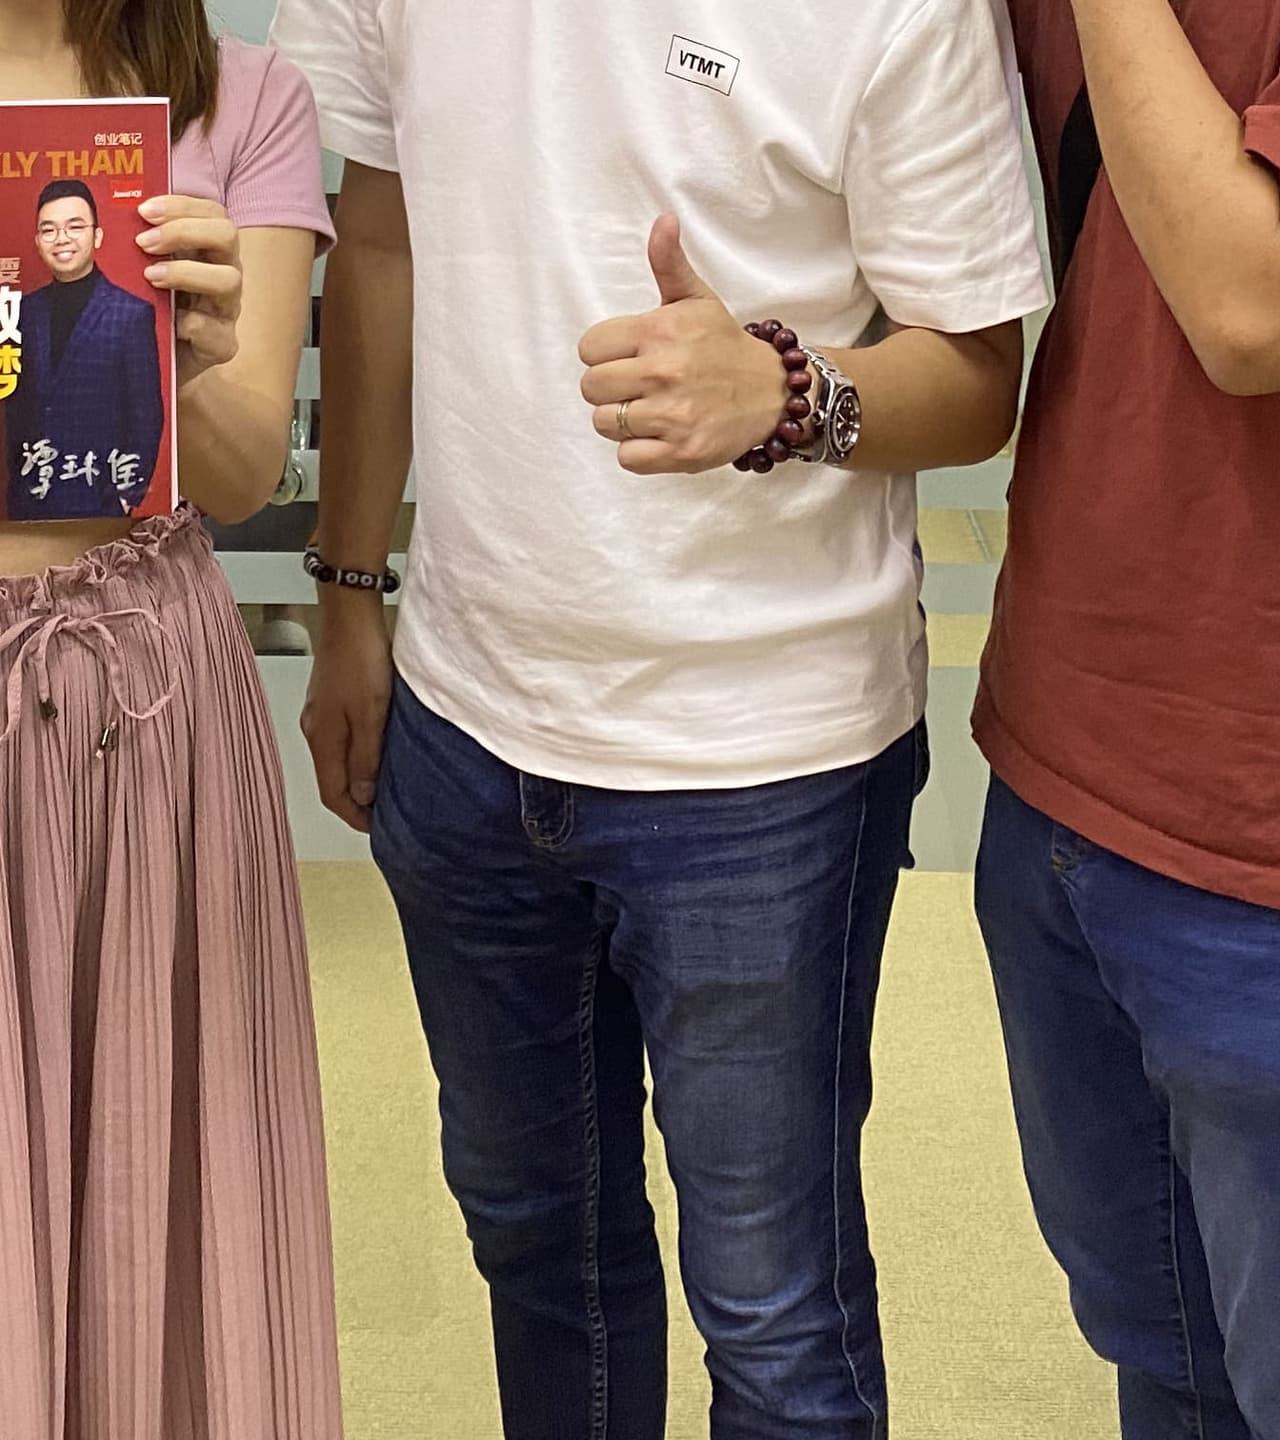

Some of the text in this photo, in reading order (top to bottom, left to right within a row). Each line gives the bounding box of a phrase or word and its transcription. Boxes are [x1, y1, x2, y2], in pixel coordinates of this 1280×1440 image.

[678, 49, 727, 80] VTMT
[94, 132, 144, 146] 创业笔记
[45, 148, 145, 178] THAM
